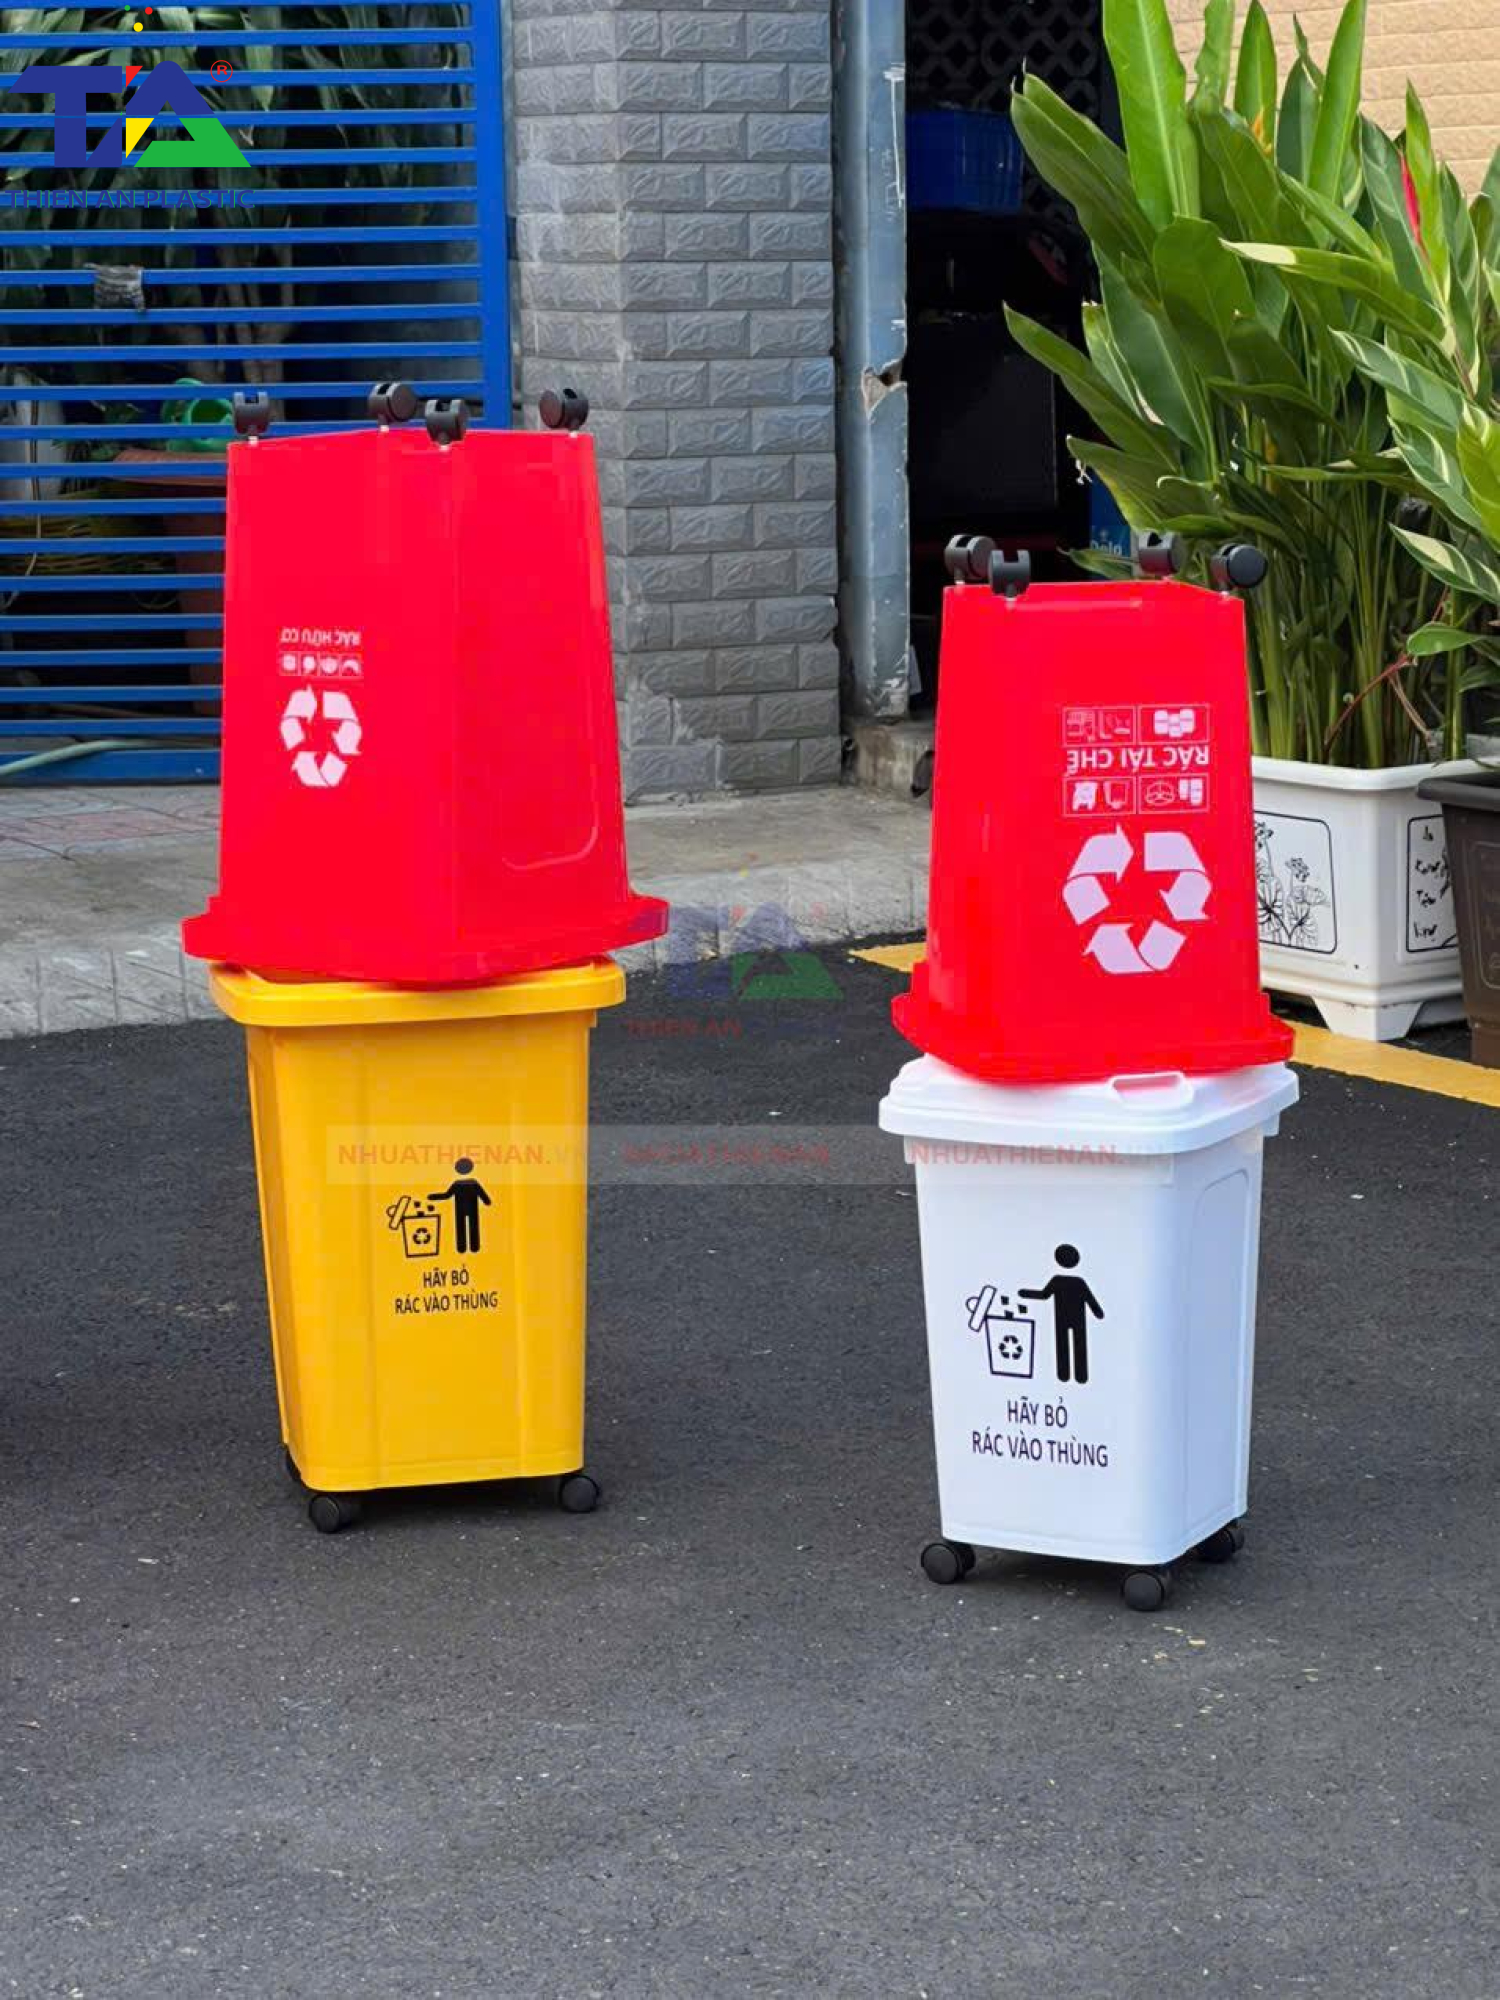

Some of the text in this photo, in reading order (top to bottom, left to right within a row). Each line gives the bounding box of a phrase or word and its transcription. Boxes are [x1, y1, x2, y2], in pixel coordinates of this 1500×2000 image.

[1120, 746, 1156, 773] TÁI
[1163, 744, 1209, 770] RÁC
[423, 1264, 470, 1289] HÃY BỎ
[395, 1289, 498, 1315] RÁC VÀO THÙNG
[1007, 1396, 1068, 1428] HÃY BỎ
[972, 1426, 1109, 1468] RÁC VÀO THÙNG
